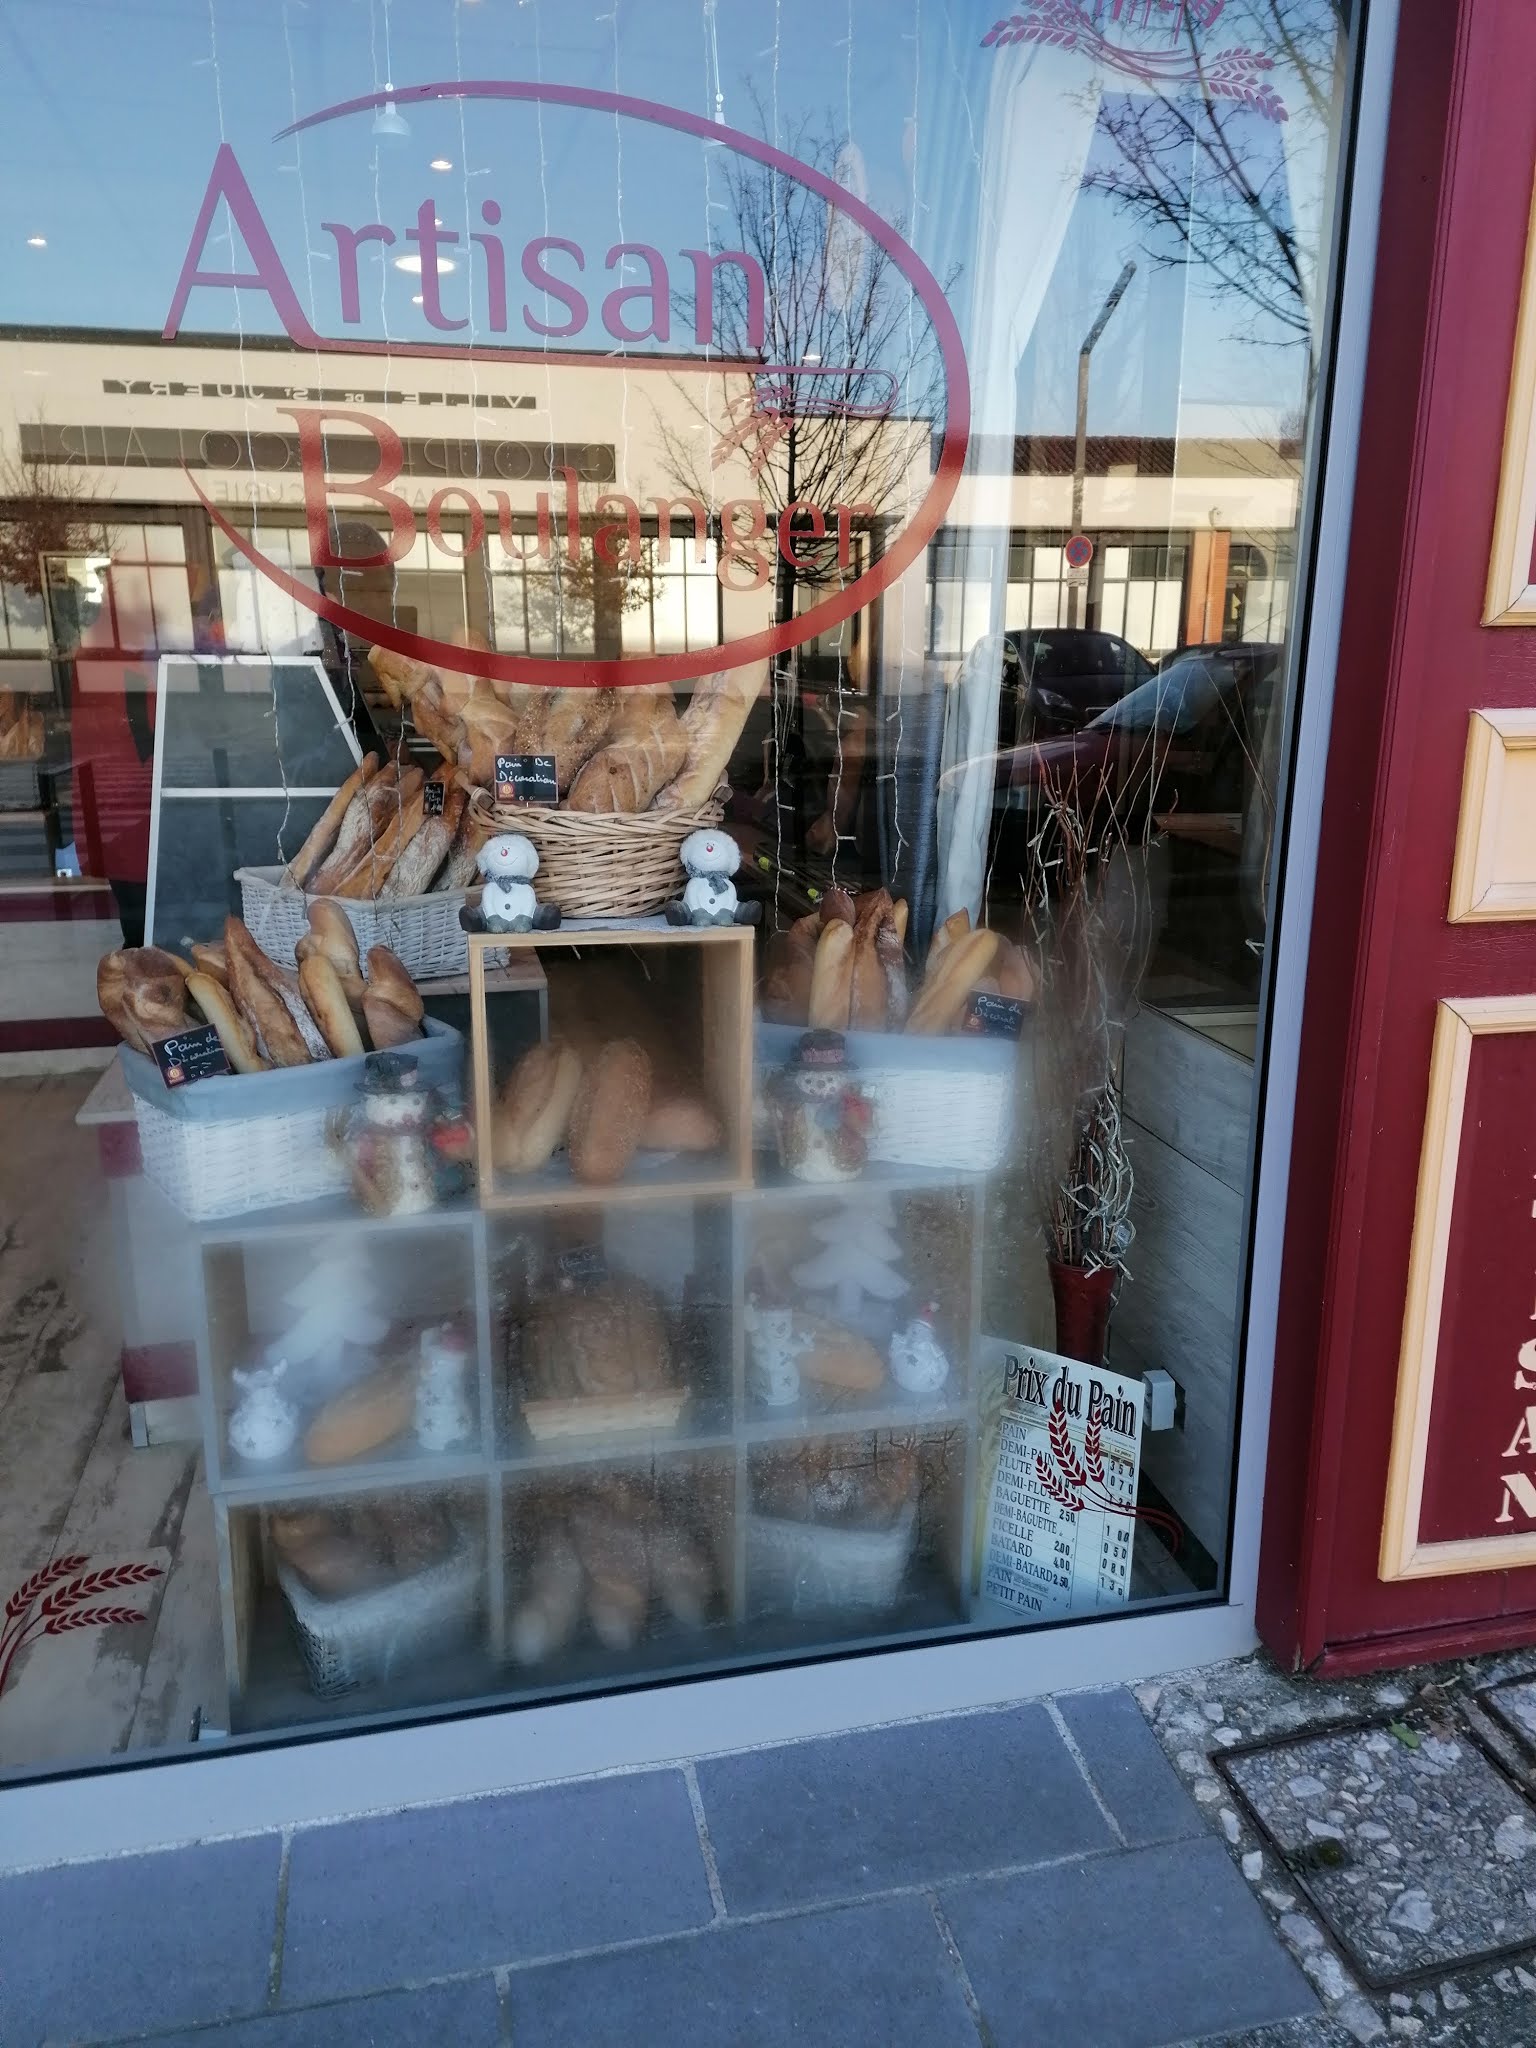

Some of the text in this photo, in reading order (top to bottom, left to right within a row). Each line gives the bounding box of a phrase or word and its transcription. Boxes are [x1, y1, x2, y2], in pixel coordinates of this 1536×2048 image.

[163, 143, 766, 349] Artisan
[277, 407, 875, 592] Boulanger
[497, 757, 522, 768] Pain
[164, 1040, 202, 1056] Pain
[1001, 1353, 1136, 1440] Prix du Pain
[1002, 1422, 1027, 1440] PAIN
[999, 1454, 1032, 1475] FLUTE
[1000, 1438, 1055, 1466] DEMI-PAIN
[997, 1469, 1057, 1500] DEMI-FLU
[995, 1485, 1051, 1515] BAGUETTE
[992, 1517, 1035, 1542] FICELLE
[993, 1500, 1058, 1535] DEMI-BAGUETTE
[991, 1532, 1033, 1558] BATARD
[987, 1564, 1013, 1584] PAIN
[989, 1548, 1053, 1582] DEMI-BATARD
[986, 1580, 1016, 1602] PETIT
[1017, 1591, 1043, 1612] PAIN
